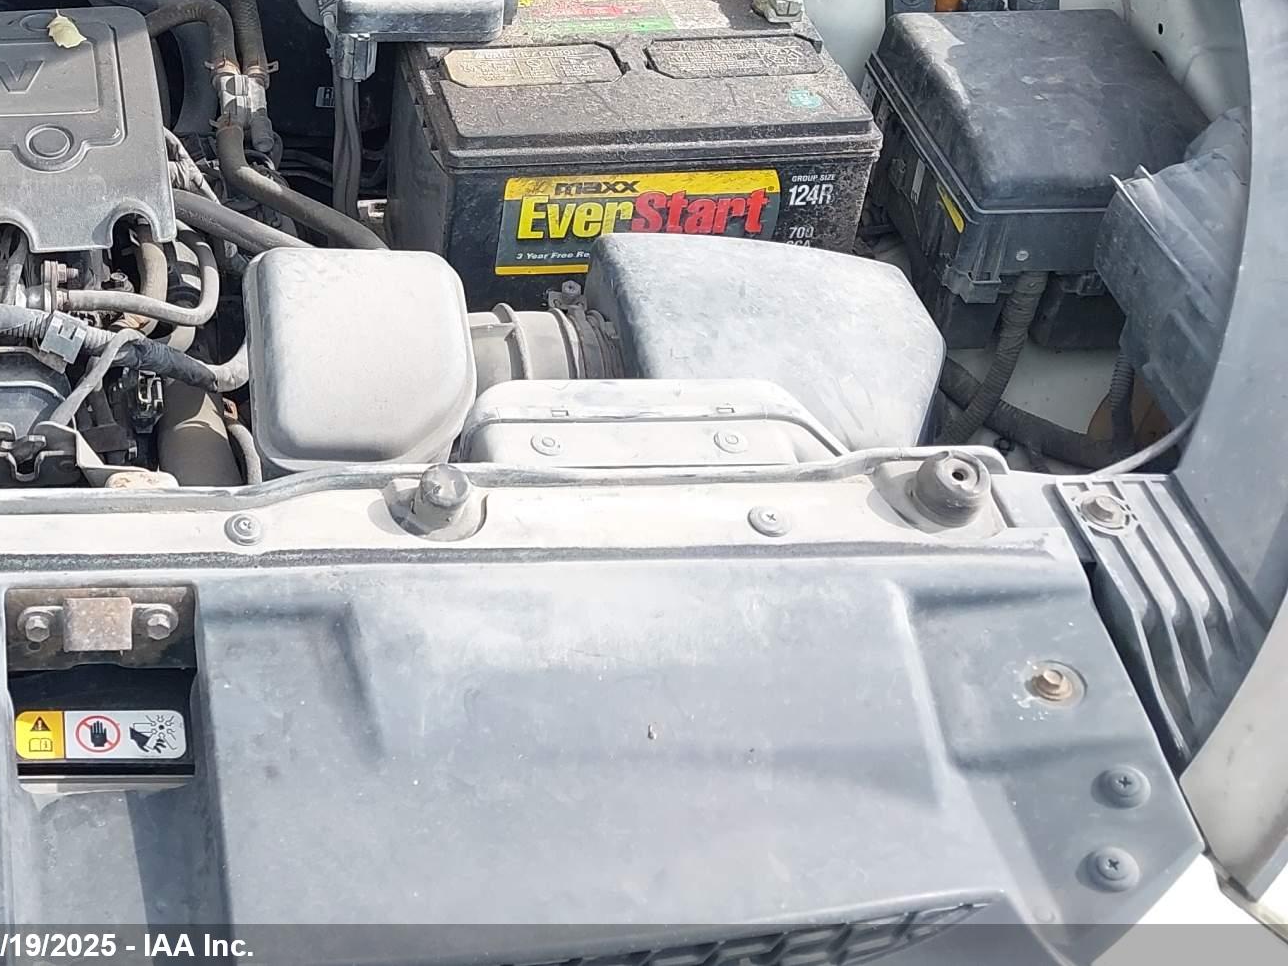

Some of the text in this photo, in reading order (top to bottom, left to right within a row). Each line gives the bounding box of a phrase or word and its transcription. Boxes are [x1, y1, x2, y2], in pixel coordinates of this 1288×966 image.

[791, 173, 836, 183] GROUP SIZE
[788, 183, 834, 206] 124R
[517, 188, 769, 240] EverStart
[789, 226, 815, 239] 700
[516, 250, 591, 260] 3 Year Free Re
